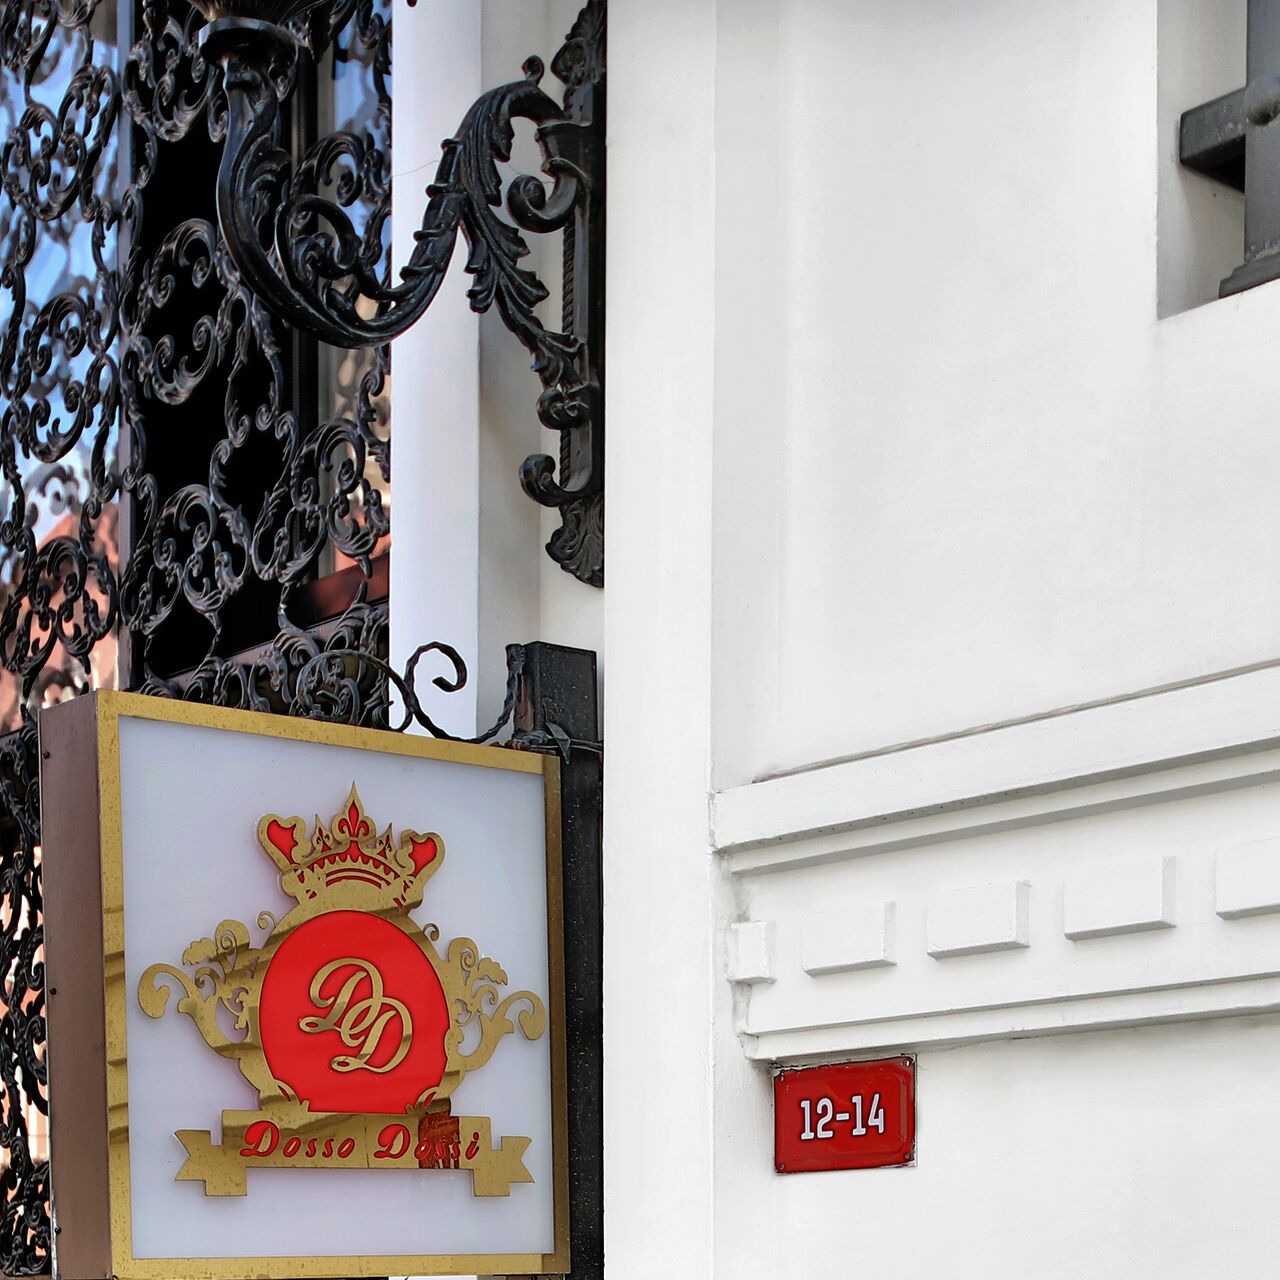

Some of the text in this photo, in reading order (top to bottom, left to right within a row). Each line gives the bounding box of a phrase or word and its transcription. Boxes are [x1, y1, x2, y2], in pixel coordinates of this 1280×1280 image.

[800, 1093, 885, 1141] 12-14
[239, 1120, 480, 1160] Dosso Dossi
